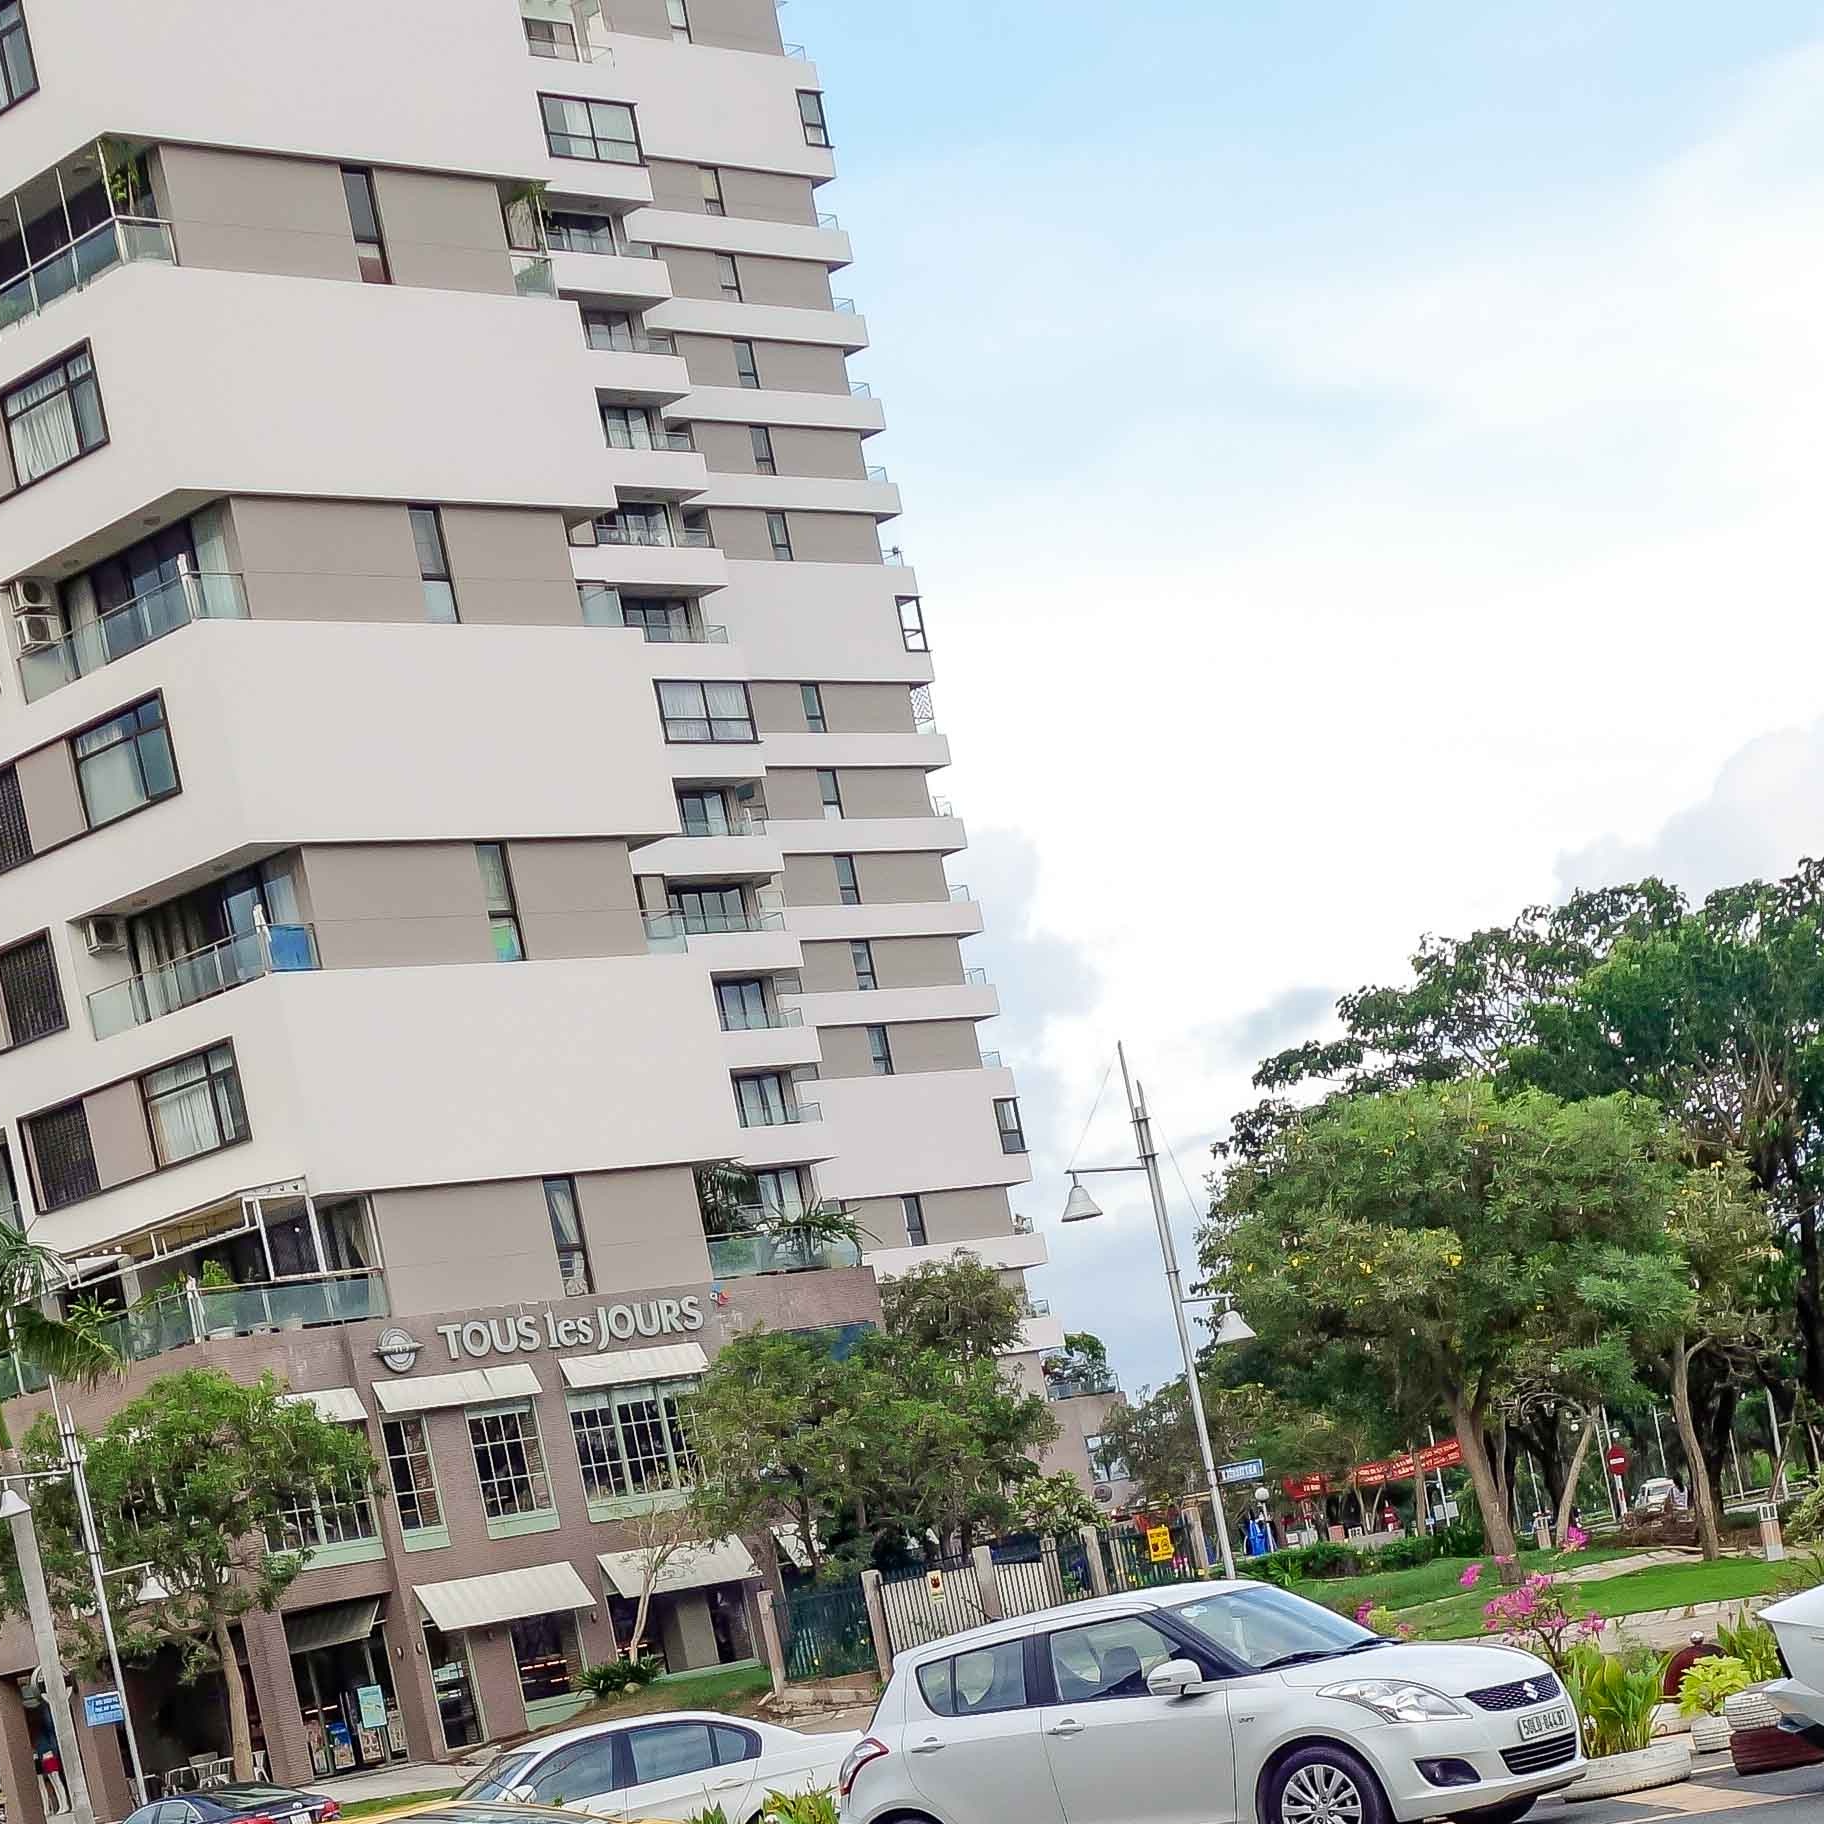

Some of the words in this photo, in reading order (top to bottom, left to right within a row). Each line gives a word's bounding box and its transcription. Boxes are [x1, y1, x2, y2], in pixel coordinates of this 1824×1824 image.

[437, 1315, 541, 1359] TOUS
[545, 1303, 595, 1350] les
[596, 1296, 705, 1350] JOURS
